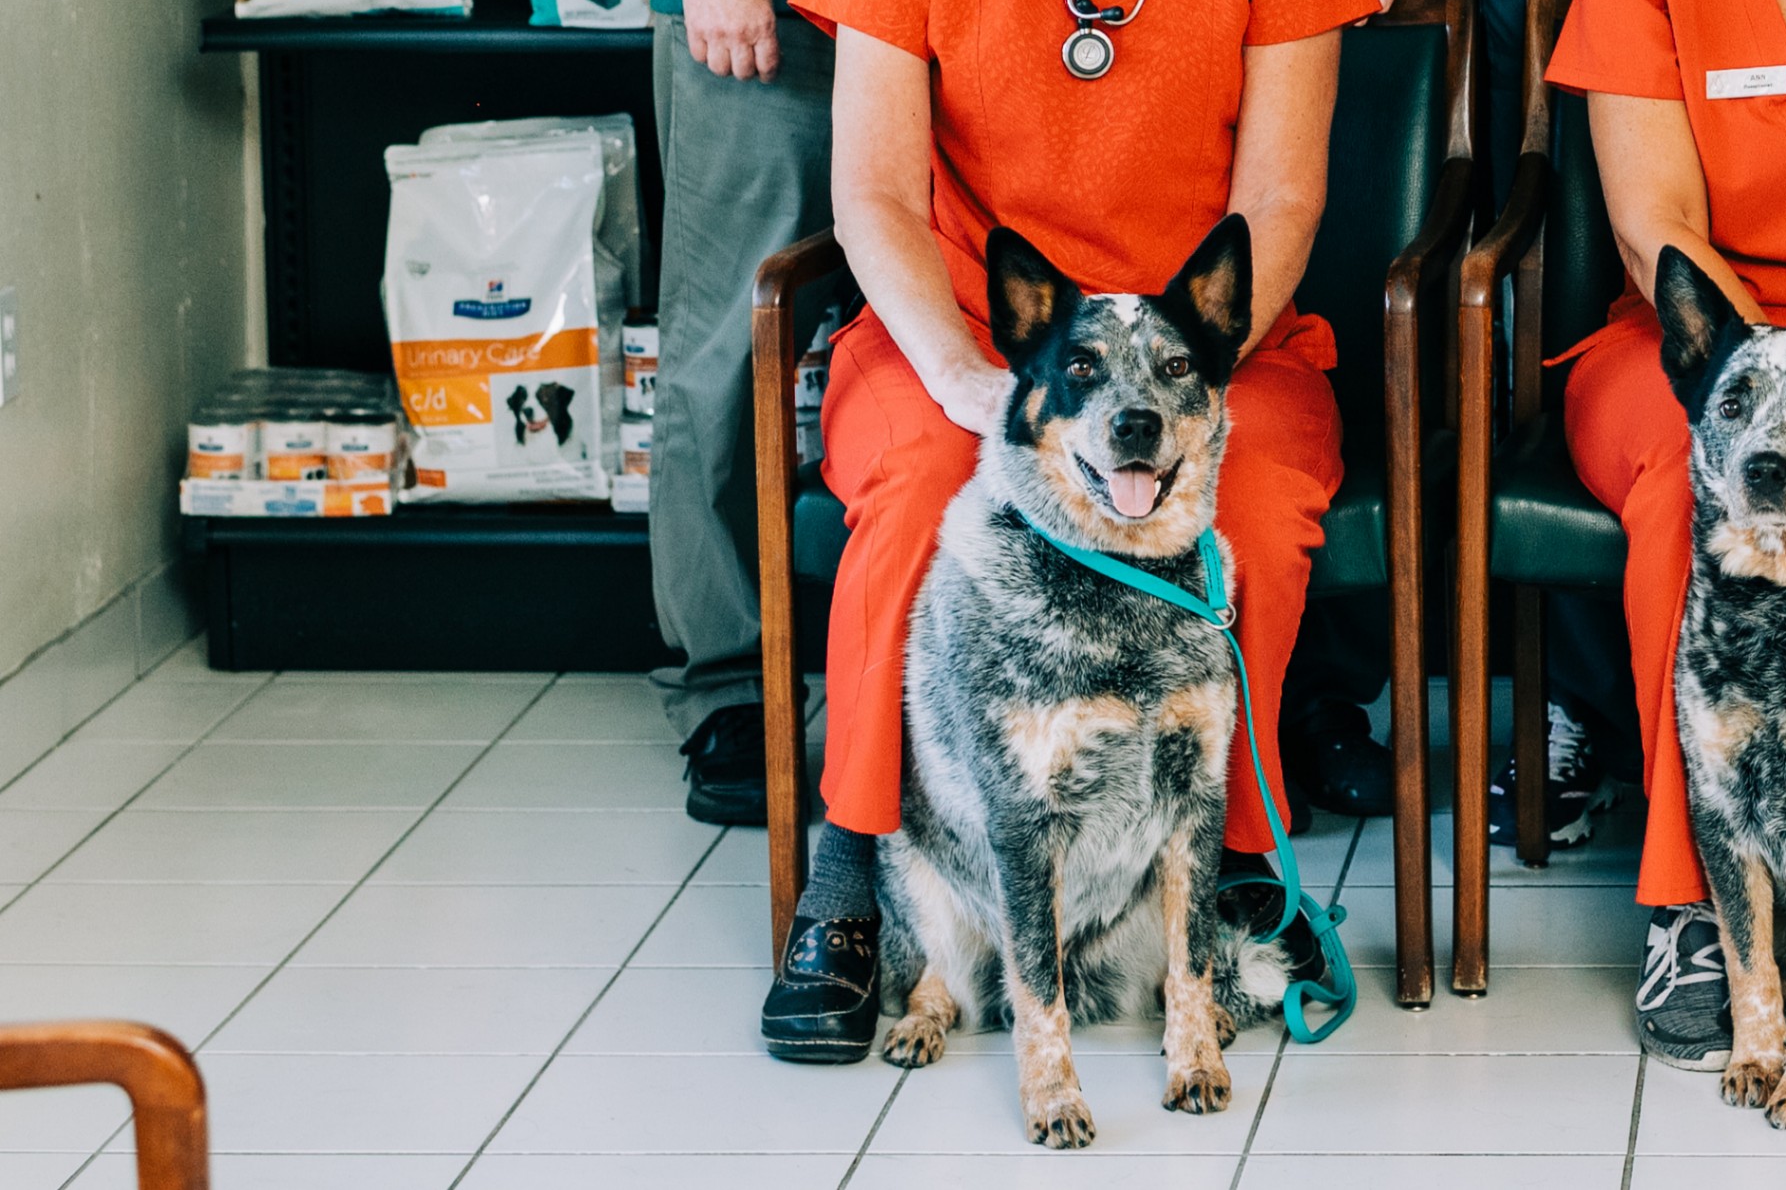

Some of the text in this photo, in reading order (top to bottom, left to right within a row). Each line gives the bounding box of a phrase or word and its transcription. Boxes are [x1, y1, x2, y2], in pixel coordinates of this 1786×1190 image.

[406, 343, 541, 369] Urinary Care
[410, 387, 447, 411] c/d
